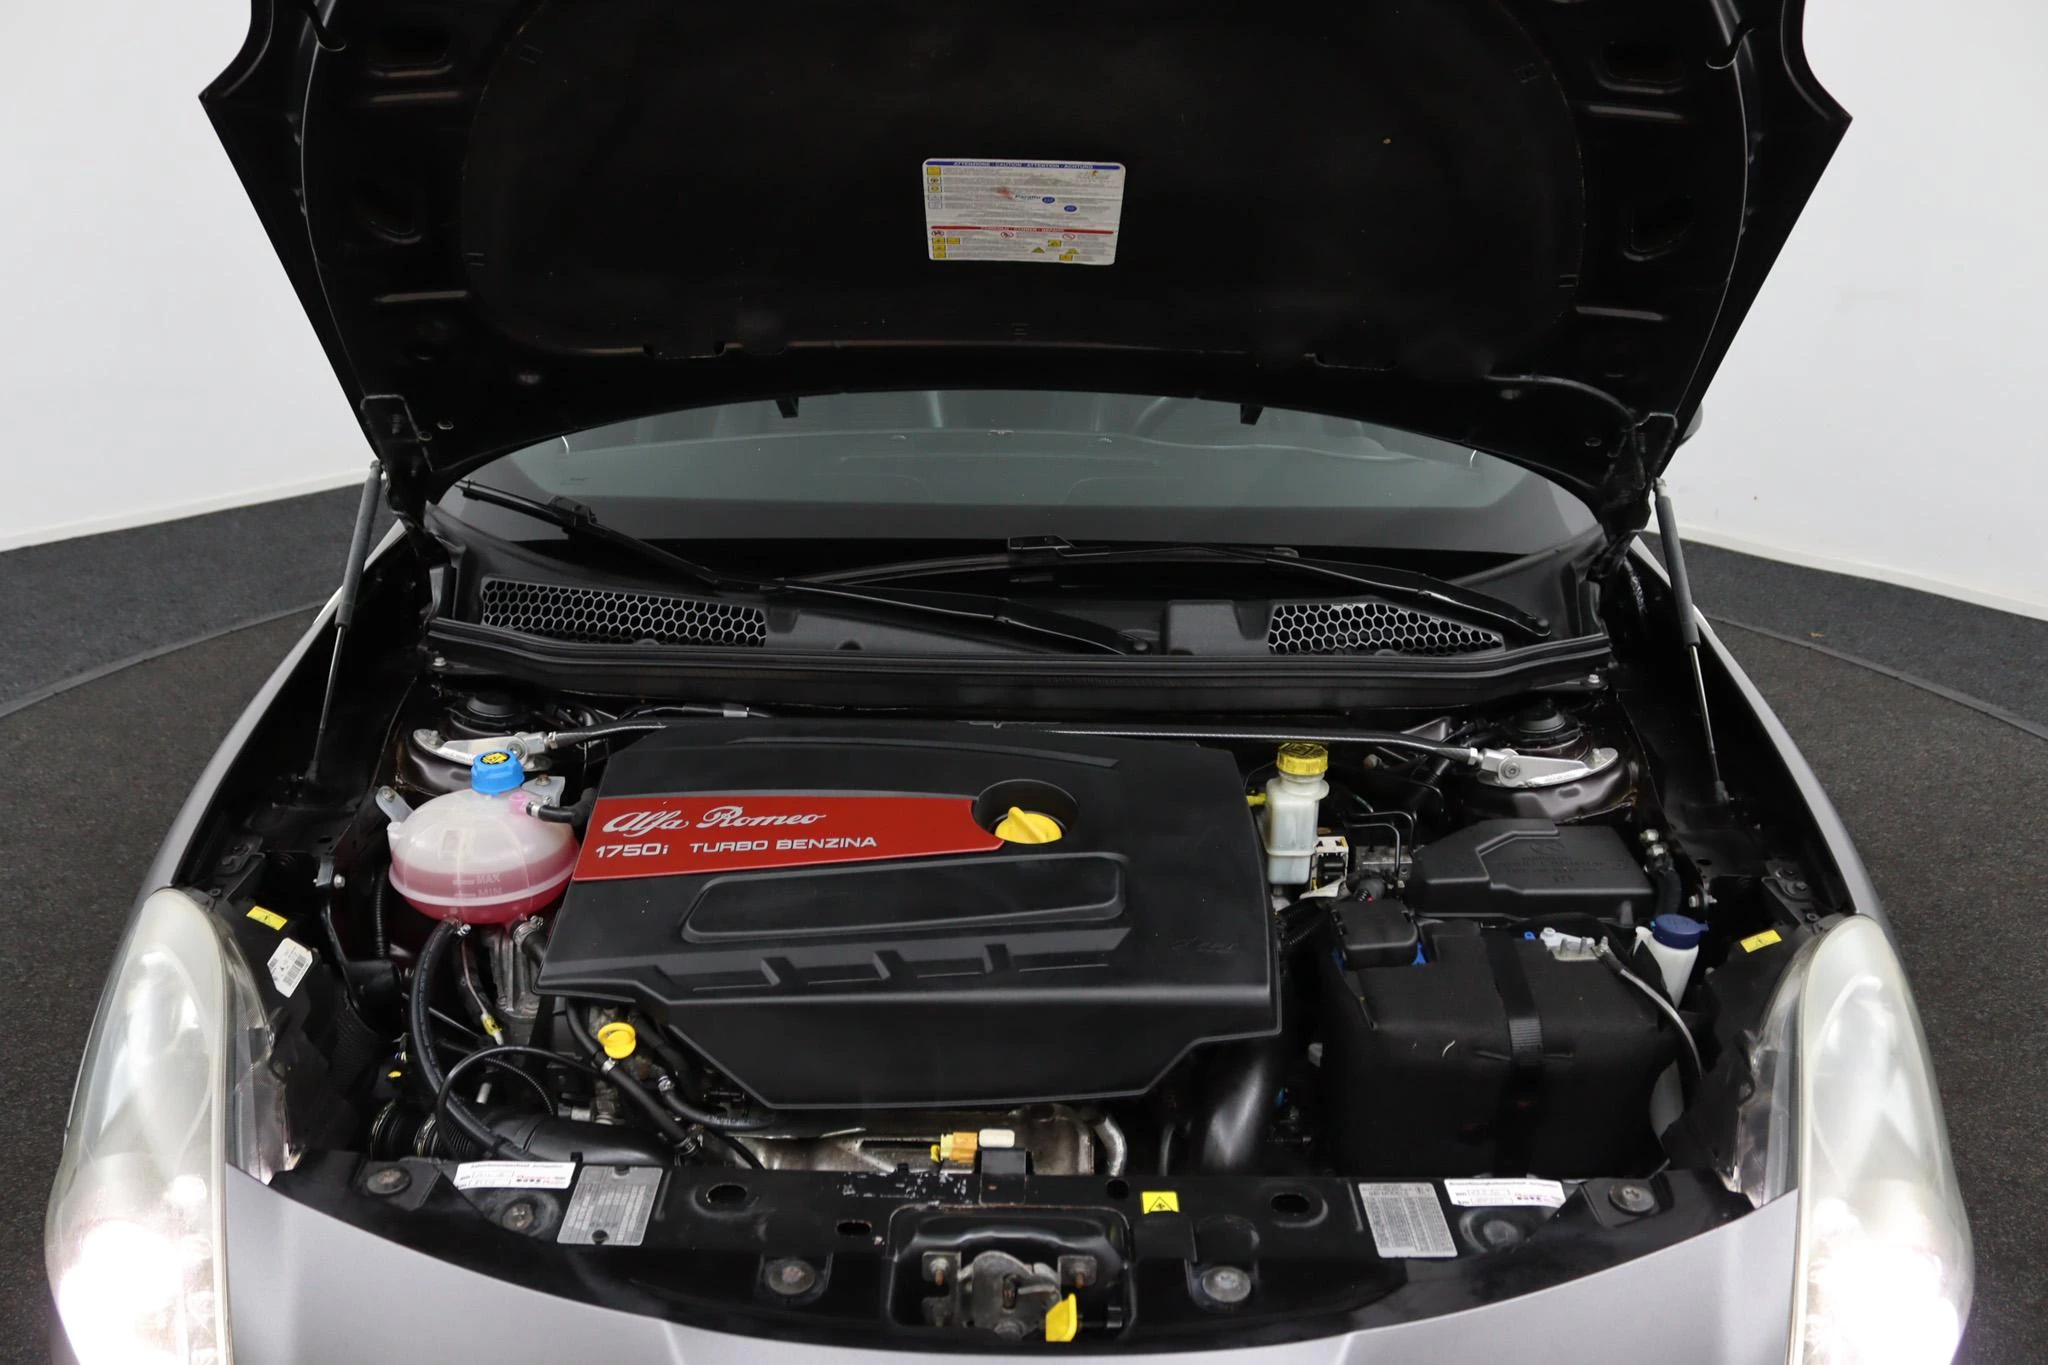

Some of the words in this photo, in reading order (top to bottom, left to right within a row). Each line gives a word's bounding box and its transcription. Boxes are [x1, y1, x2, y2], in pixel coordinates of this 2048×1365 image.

[602, 809, 690, 838] Alfa
[696, 805, 827, 829] Romeo
[595, 842, 668, 858] 1750i
[689, 839, 769, 854] TURBO
[775, 836, 877, 851] BENZINA
[476, 872, 501, 884] MAX
[478, 887, 502, 897] MIN
